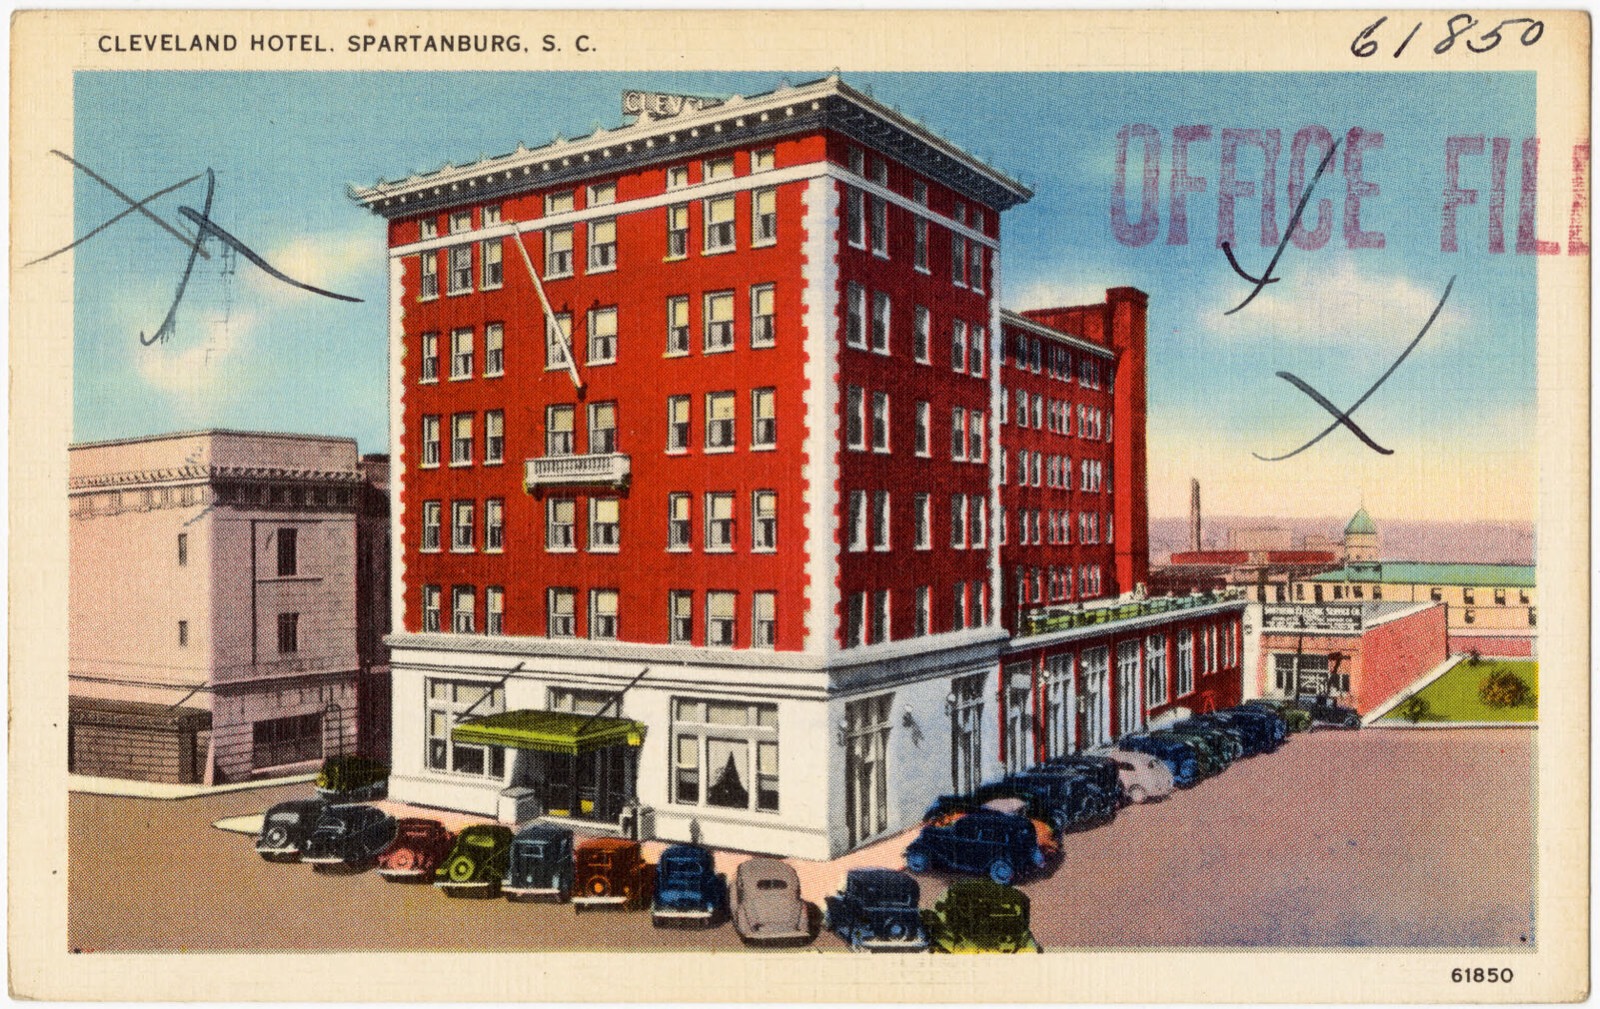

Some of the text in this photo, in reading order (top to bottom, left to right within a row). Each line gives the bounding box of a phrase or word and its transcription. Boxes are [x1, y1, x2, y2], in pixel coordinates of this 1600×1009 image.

[98, 34, 237, 52] CLEVELAND
[542, 34, 561, 53] S.
[575, 34, 597, 53] C.
[1350, 13, 1545, 59] 61850
[1110, 123, 1386, 251] OFFICE
[1451, 967, 1514, 984] 61850
